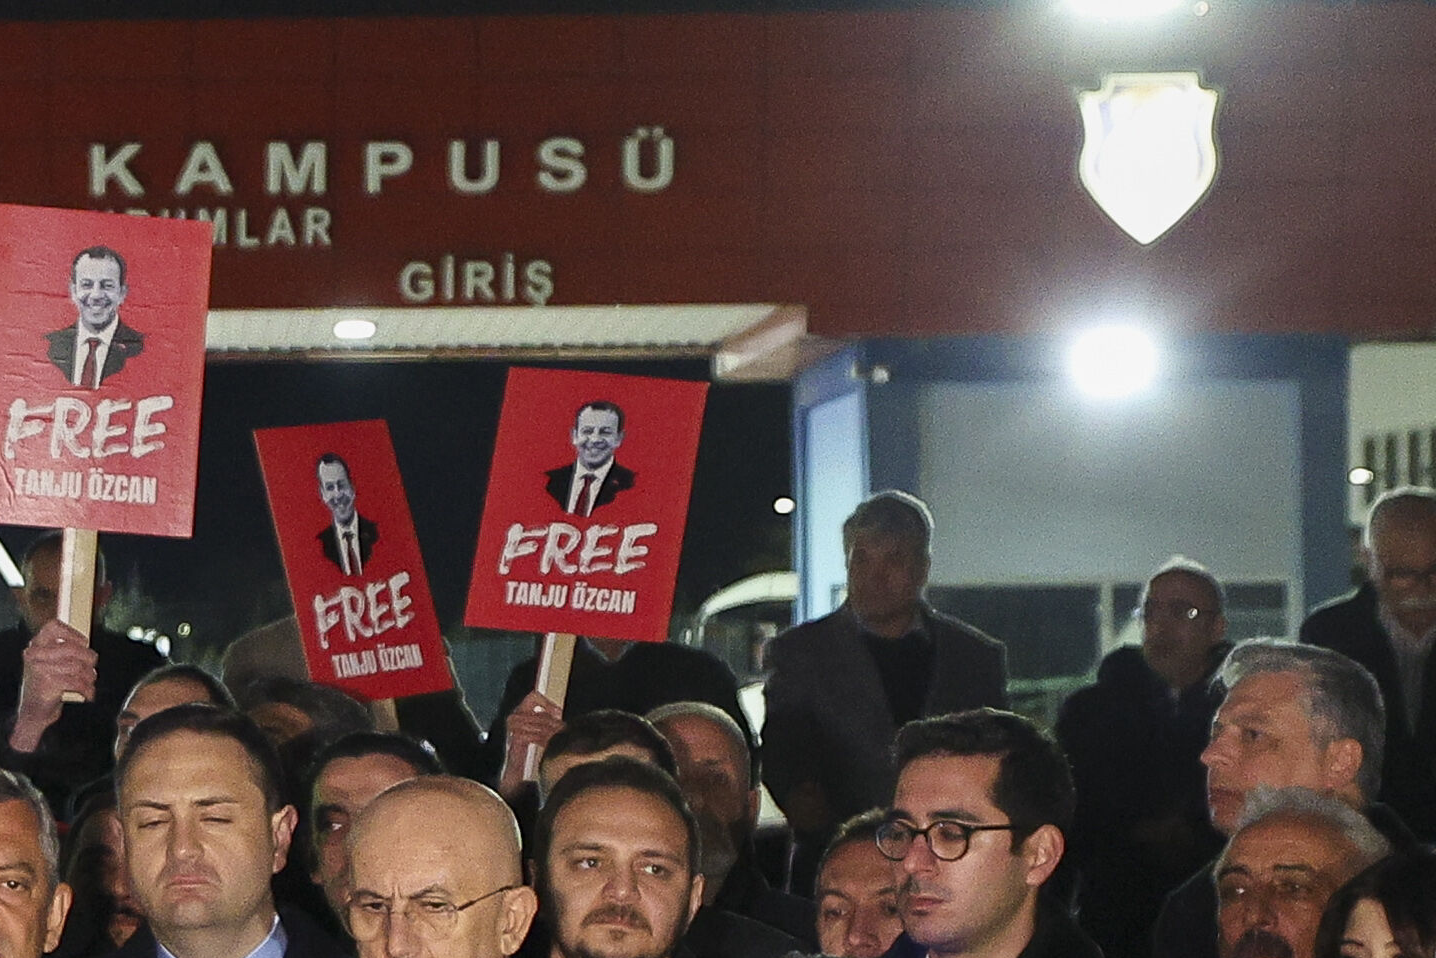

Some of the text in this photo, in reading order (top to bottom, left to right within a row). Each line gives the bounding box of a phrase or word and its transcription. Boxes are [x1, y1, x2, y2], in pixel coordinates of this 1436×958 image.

[87, 126, 675, 198] KAMPUSÜ
[398, 252, 554, 305] GİRİŞ
[4, 395, 174, 460] FREE
[14, 467, 158, 505] TANJU ÖZCAN
[498, 522, 658, 575] FREE
[313, 571, 416, 650] FREE
[506, 581, 636, 614] TANJU ÖZCAN
[331, 642, 424, 679] TANJU ÖZCAN
